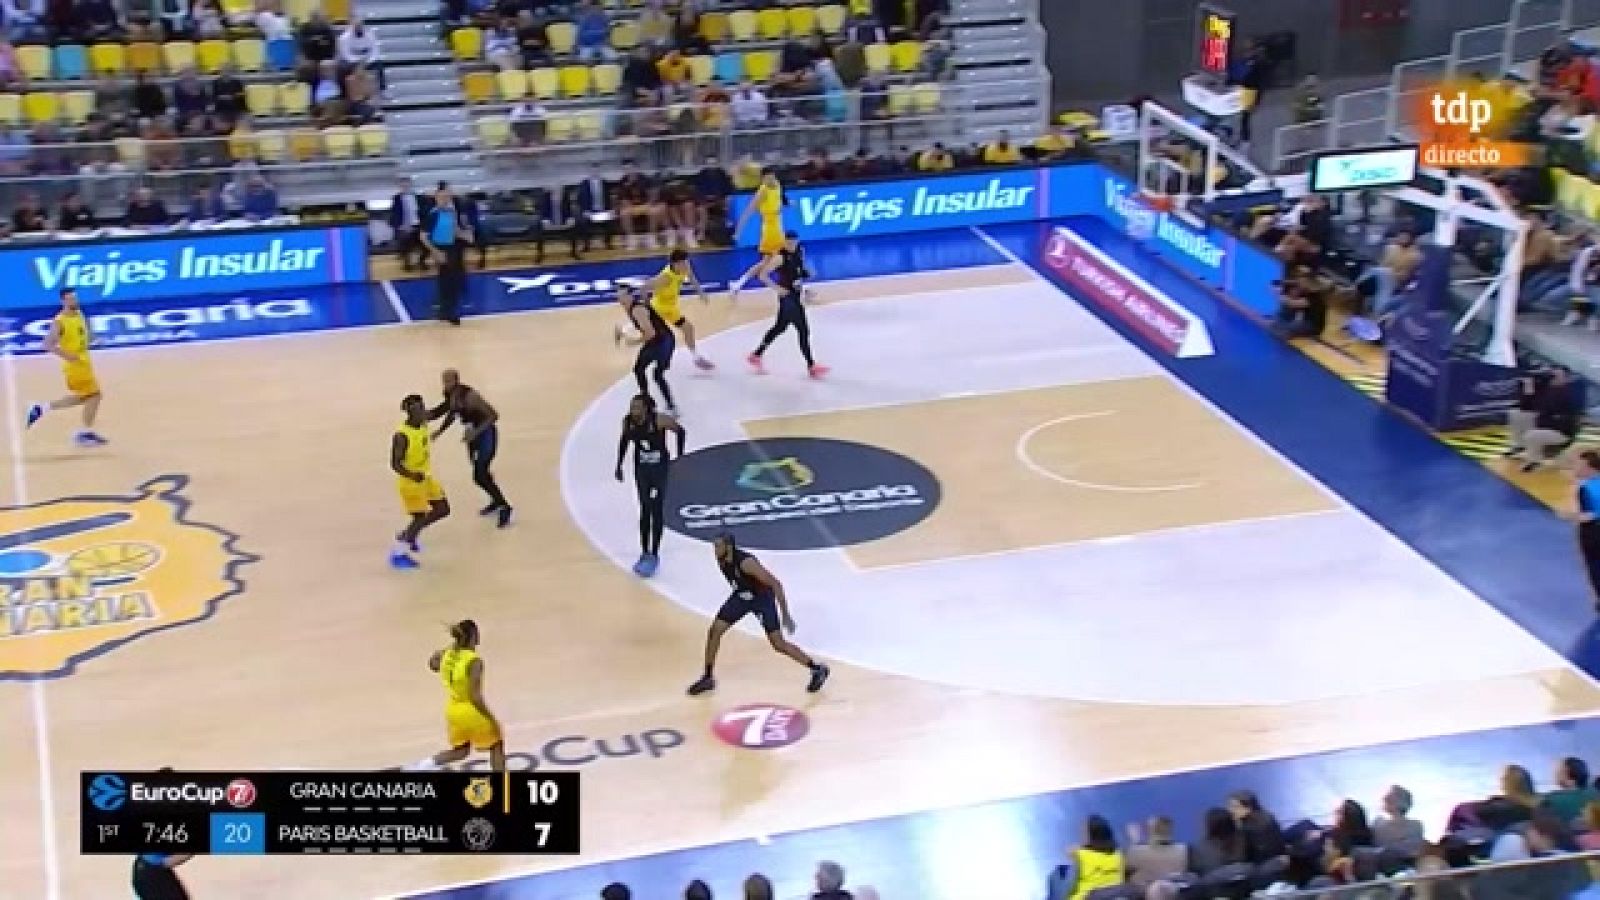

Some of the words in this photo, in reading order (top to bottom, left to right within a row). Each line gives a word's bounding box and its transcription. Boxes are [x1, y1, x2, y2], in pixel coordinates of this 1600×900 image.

[800, 190, 905, 233] Viajes
[912, 179, 1036, 216] Insular
[34, 252, 168, 296] Viajes
[179, 240, 325, 279] Insular
[722, 707, 775, 745] 7
